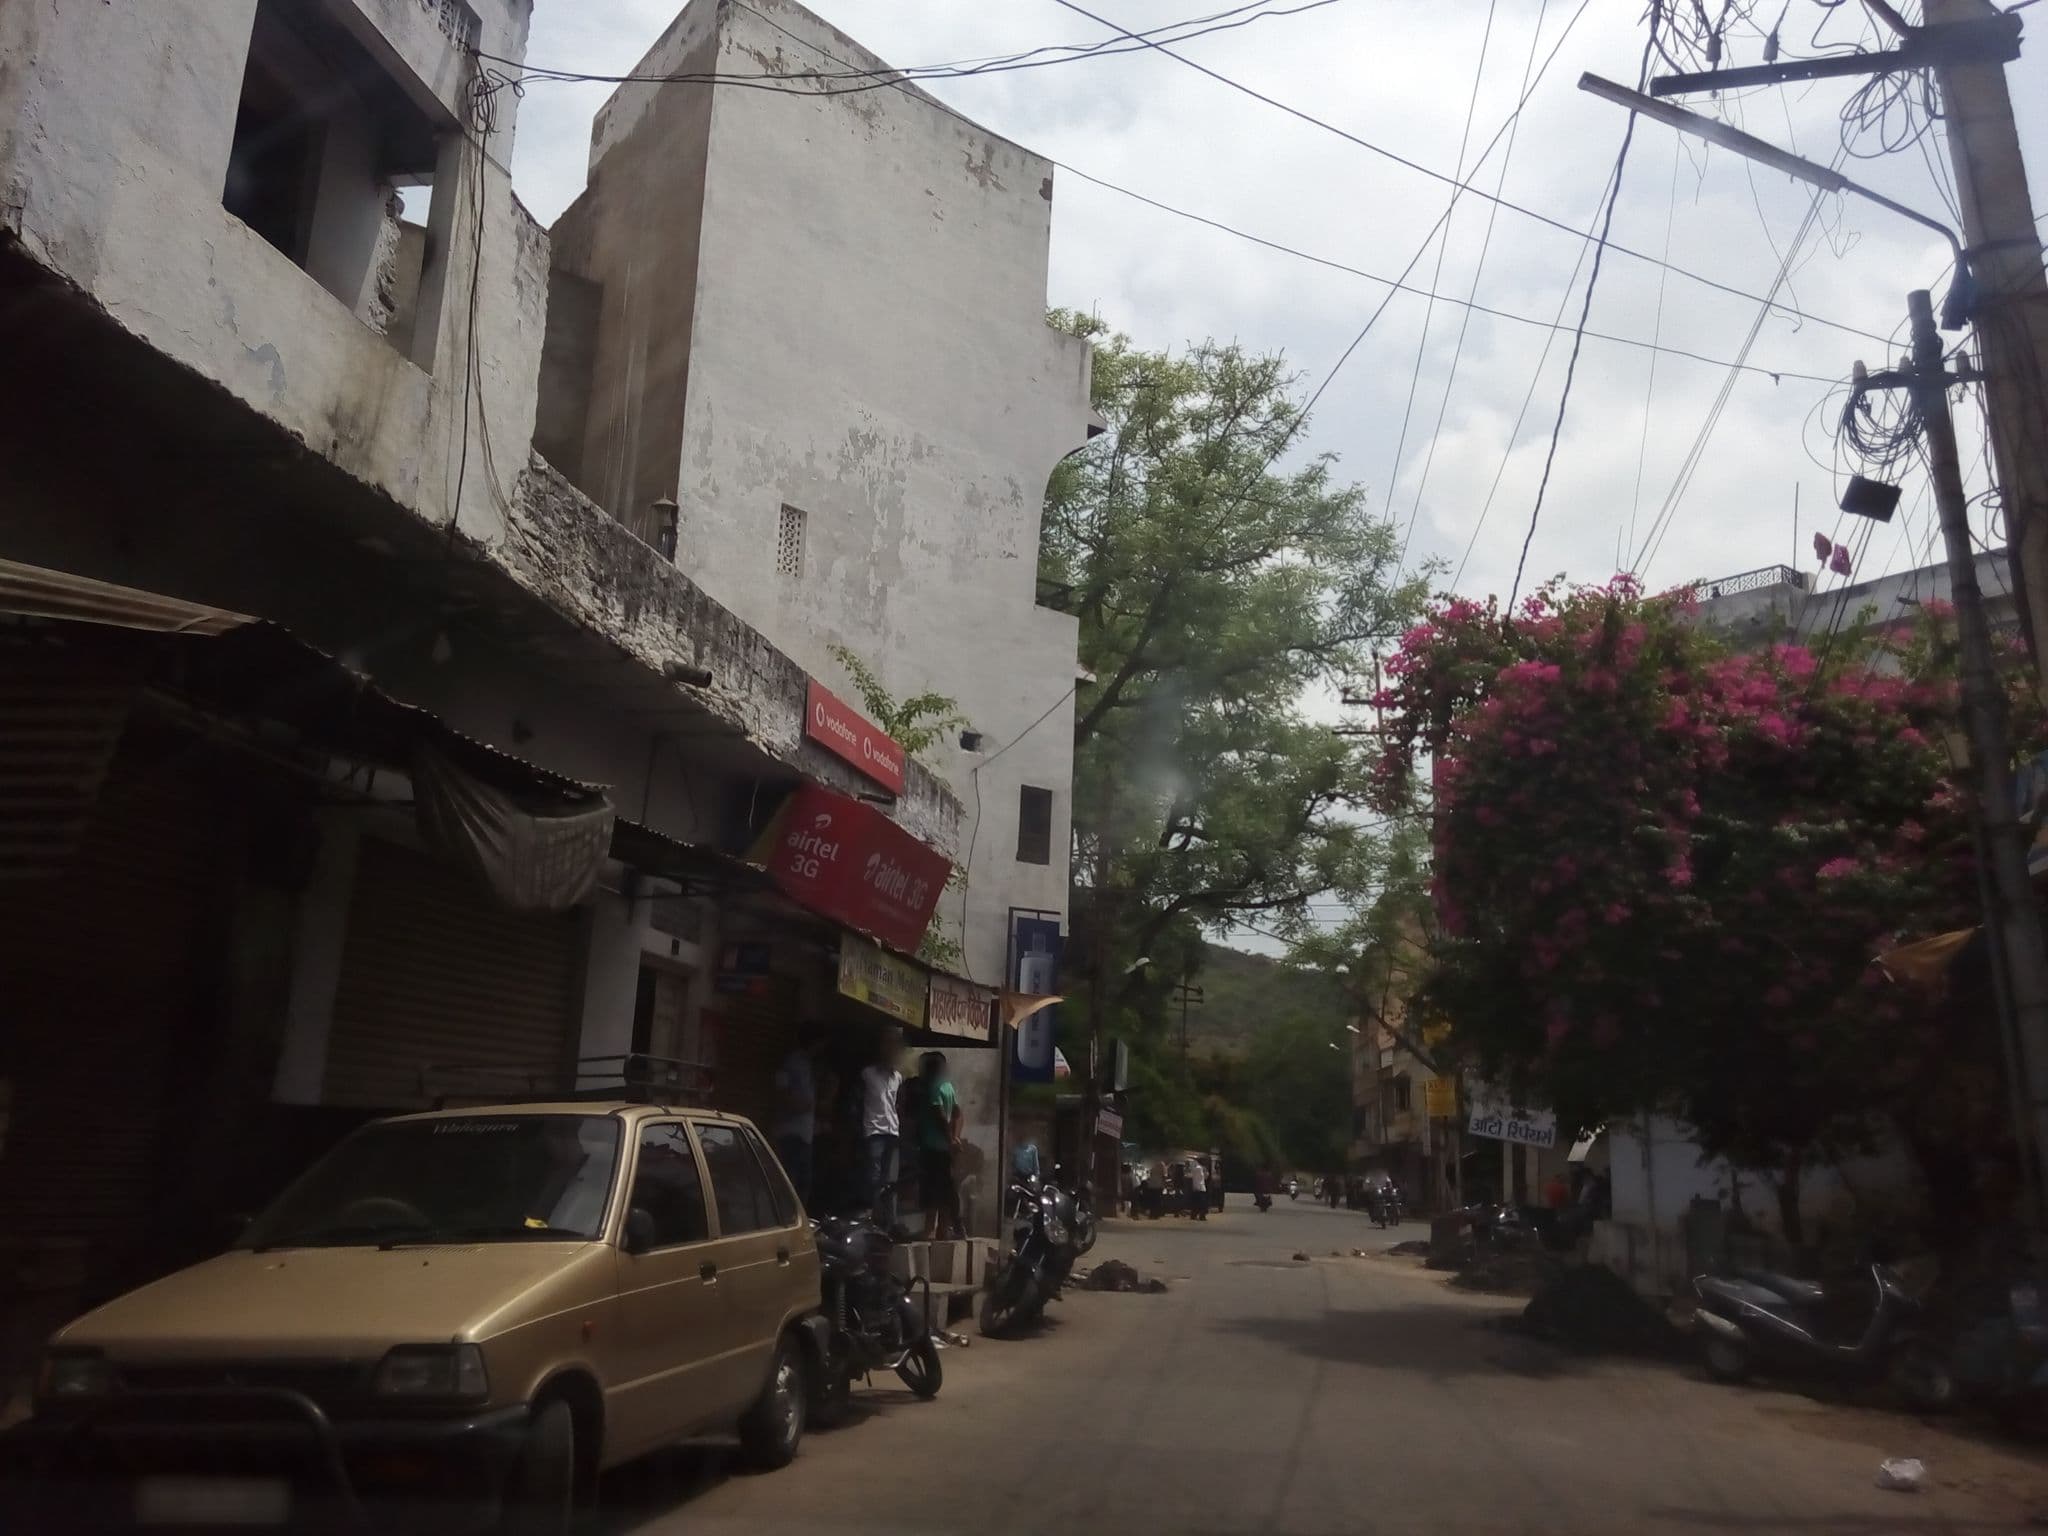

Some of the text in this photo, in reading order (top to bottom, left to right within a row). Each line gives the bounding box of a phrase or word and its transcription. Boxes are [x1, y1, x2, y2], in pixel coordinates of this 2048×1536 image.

[826, 714, 900, 777] vodafone vodafone
[787, 830, 839, 862] airtel
[790, 854, 820, 879] 3G
[874, 857, 929, 911] airtel 3G
